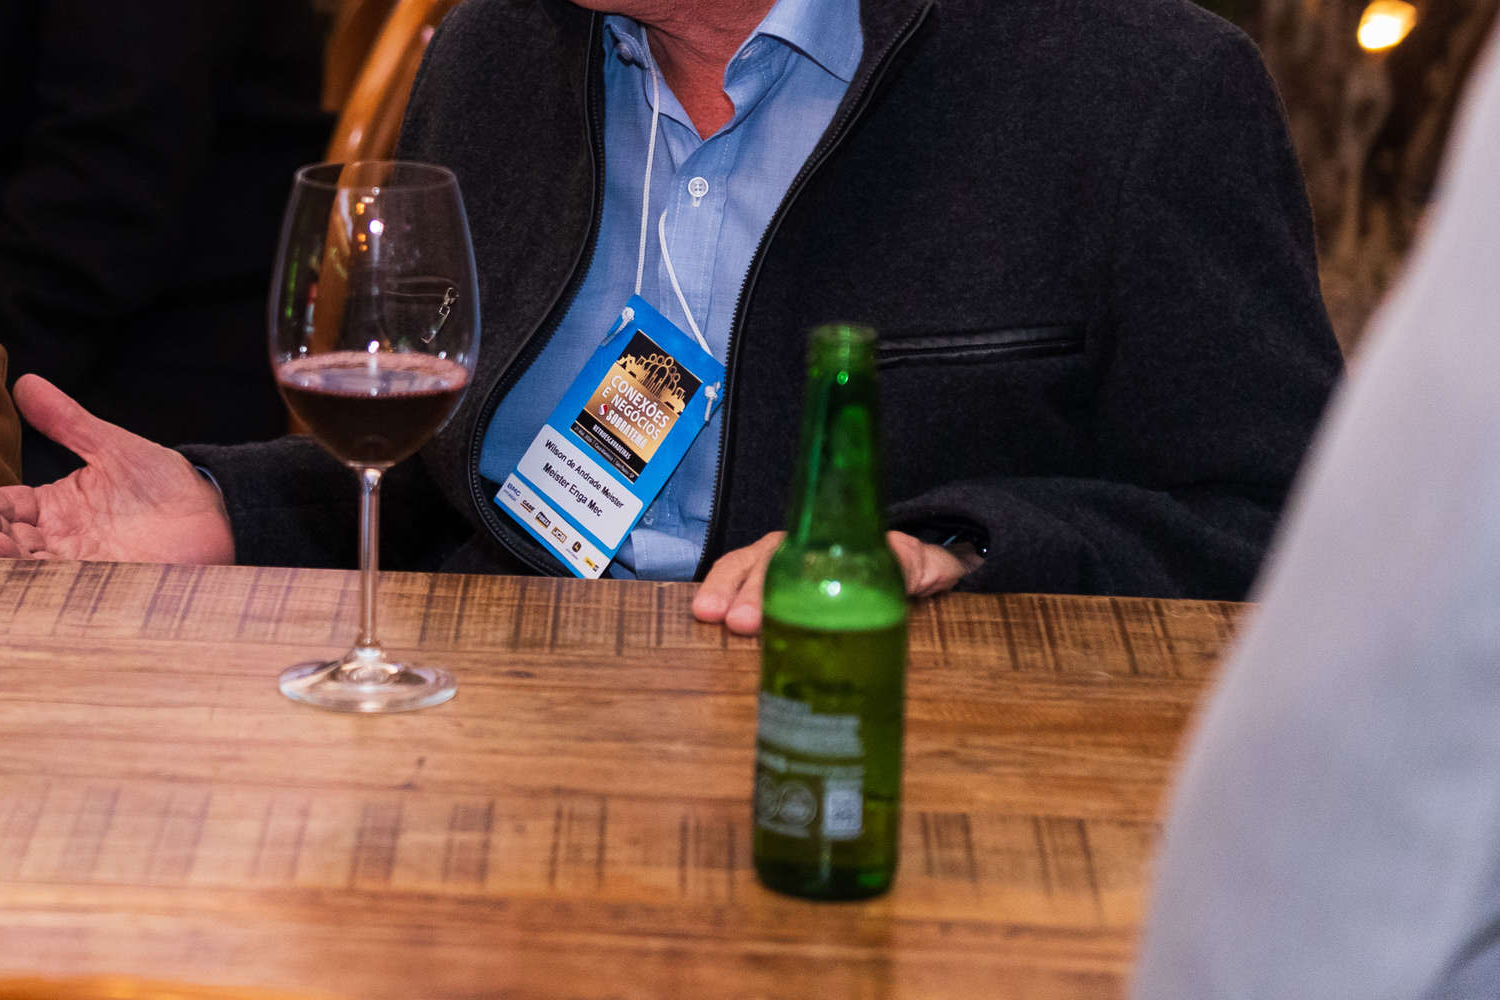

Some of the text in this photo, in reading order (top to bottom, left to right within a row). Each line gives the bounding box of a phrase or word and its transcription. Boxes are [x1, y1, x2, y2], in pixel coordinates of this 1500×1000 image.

[602, 386, 660, 440] E NEGÓCIOS
[610, 375, 670, 428] CONEXÕES
[543, 462, 603, 517] Meister Enga Mec
[545, 439, 567, 462] Wilson
[567, 457, 576, 469] de
[574, 465, 601, 490] Andrade
[601, 486, 624, 509] Meister
